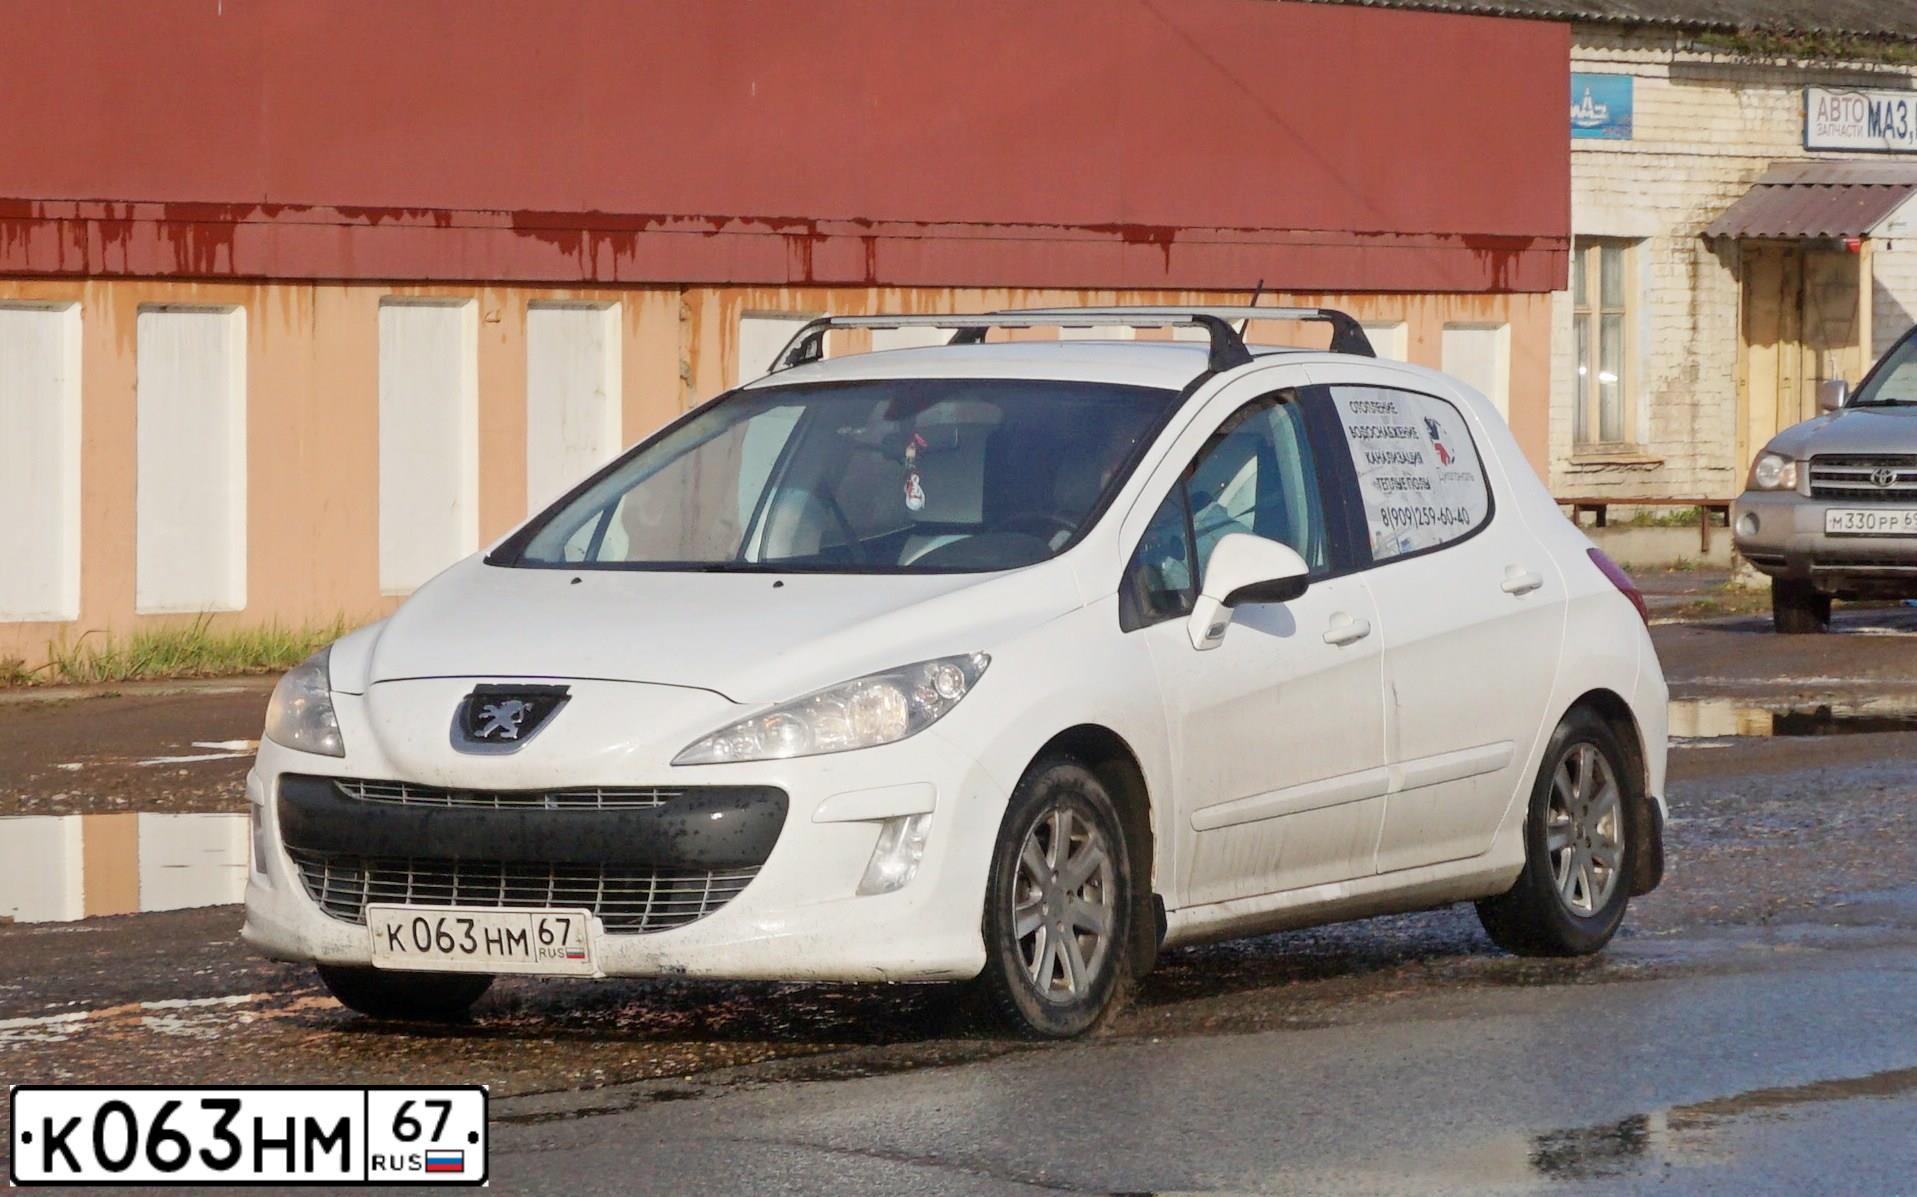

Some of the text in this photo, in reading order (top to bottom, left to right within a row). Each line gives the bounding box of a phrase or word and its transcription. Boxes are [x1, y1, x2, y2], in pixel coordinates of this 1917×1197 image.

[1817, 96, 1917, 145] АВТО МАЗ,
[1816, 123, 1864, 138] ЗАПЧАСТИ
[1349, 400, 1398, 415] ОТОПЛЕНИЕ
[1349, 425, 1420, 441] ВОДОСНАБЖЕНИЕ
[1365, 451, 1424, 467] КАНАЛИЗАЦИЯ
[1380, 506, 1471, 530] 8(909)259-60-40
[538, 917, 571, 946] 67
[538, 947, 565, 959] RUS
